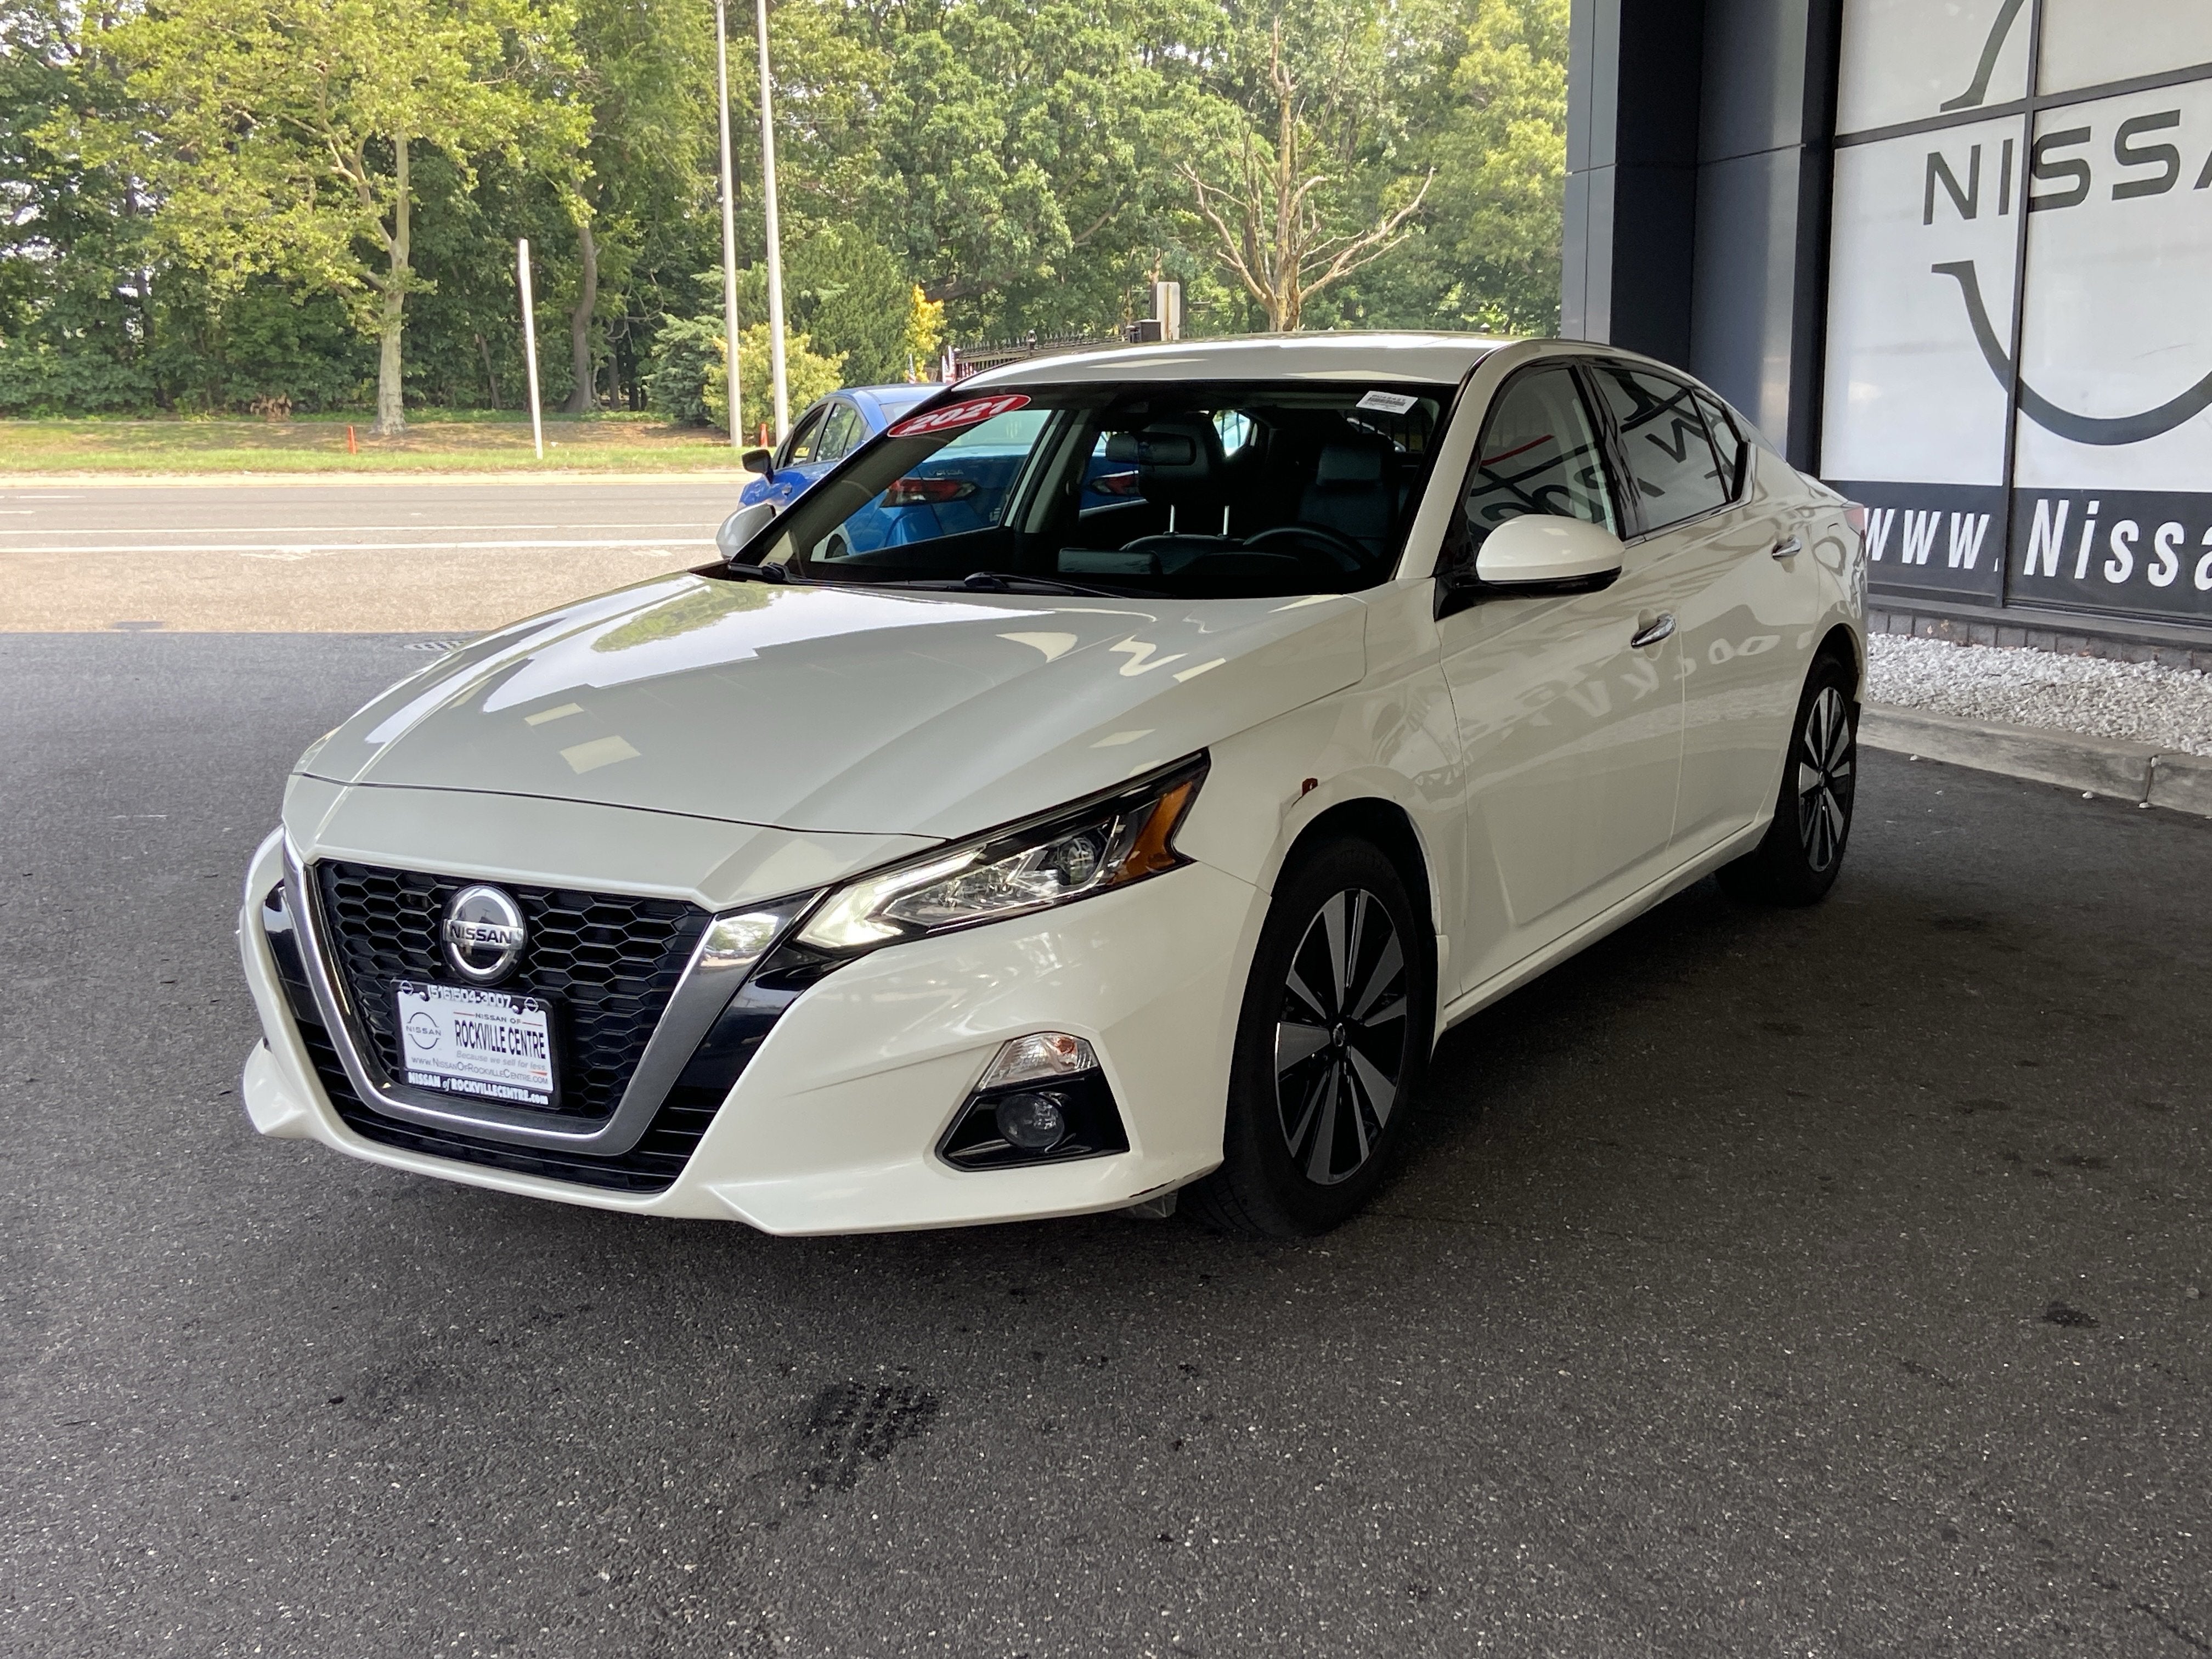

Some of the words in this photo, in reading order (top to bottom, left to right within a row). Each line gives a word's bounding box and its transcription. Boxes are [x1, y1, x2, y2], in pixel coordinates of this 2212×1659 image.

[1923, 109, 2212, 226] NISS
[900, 396, 1018, 435] 2021
[450, 923, 512, 944] NISSAN
[475, 1013, 507, 1023] NISSAN
[406, 1025, 442, 1036] NISSAN
[454, 1019, 507, 1053] ROCKVILLE
[508, 1026, 546, 1059] CENTRE
[456, 1050, 488, 1063] Because
[490, 1056, 500, 1064] we
[503, 1058, 516, 1066] sell
[518, 1060, 529, 1068] for
[408, 1071, 441, 1087] NISSAN
[443, 1077, 452, 1092] of
